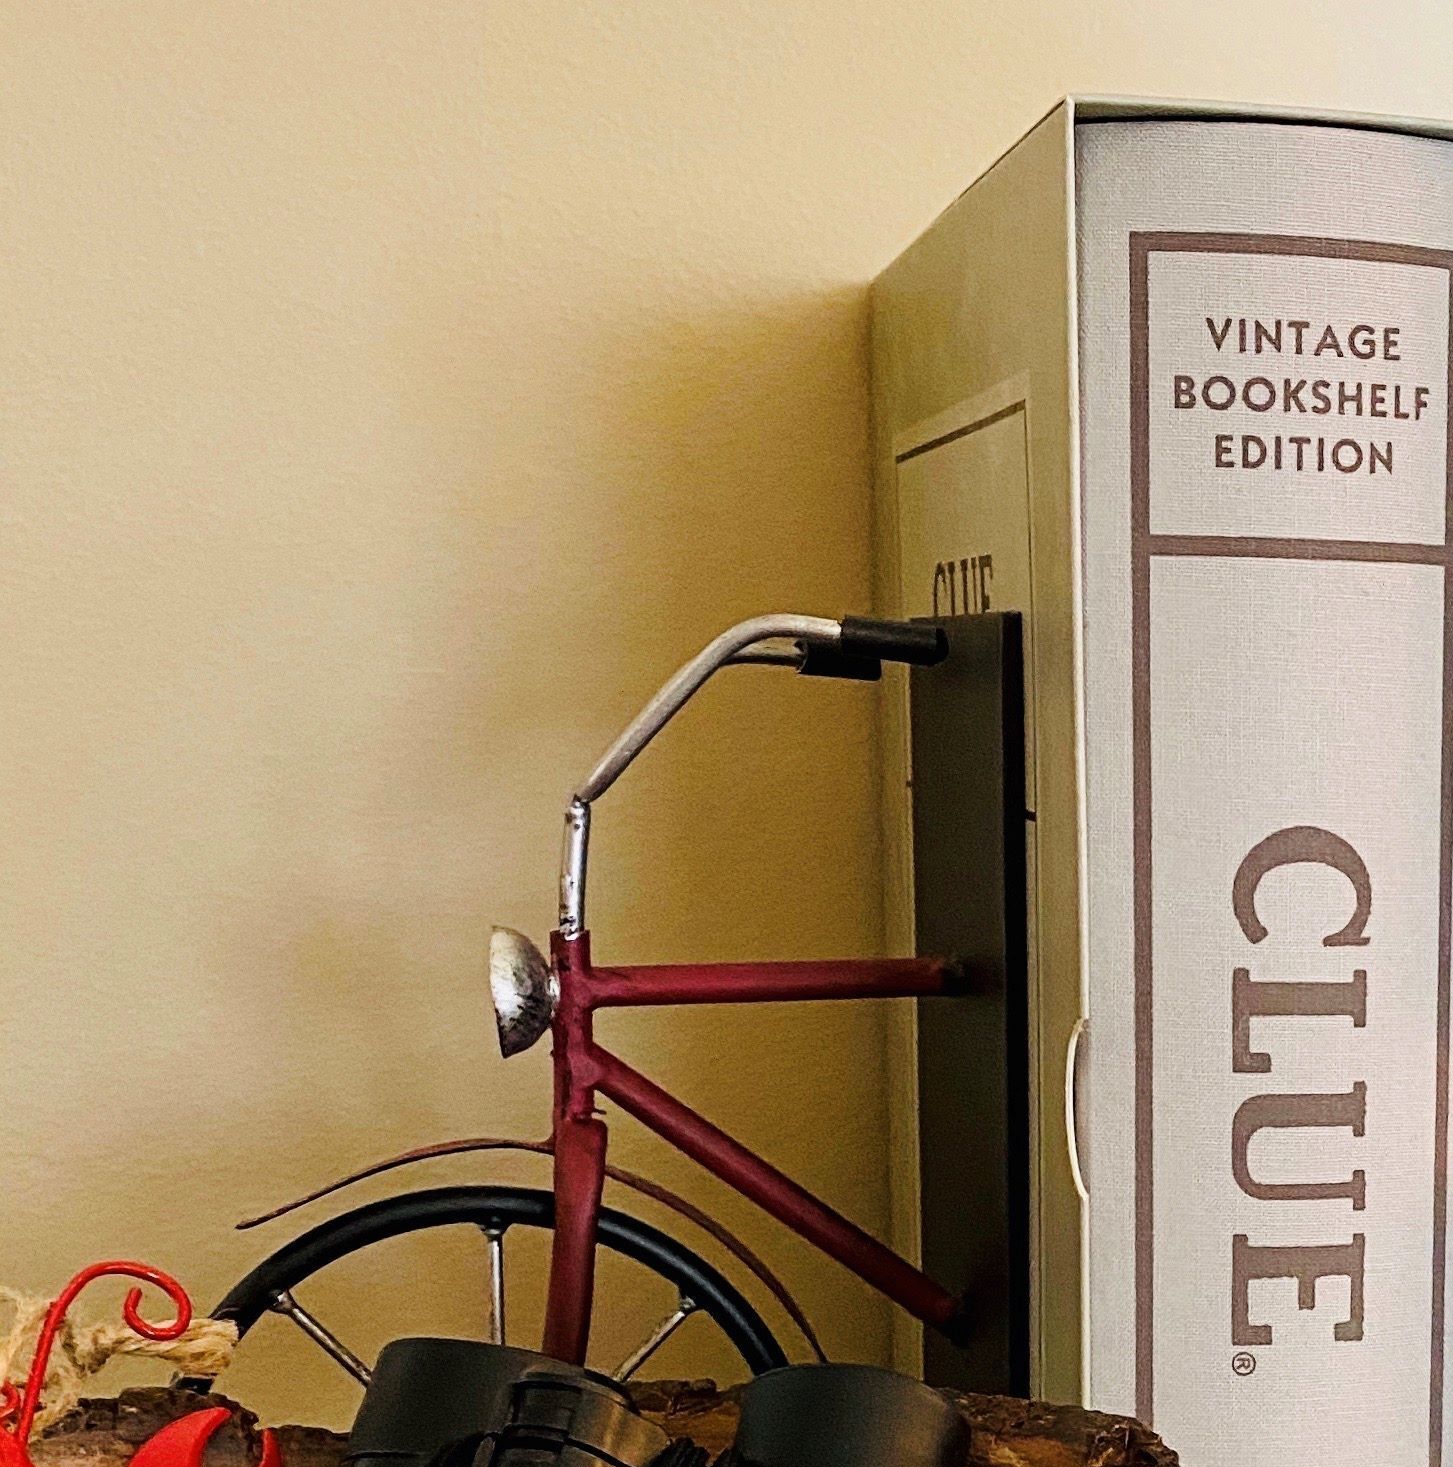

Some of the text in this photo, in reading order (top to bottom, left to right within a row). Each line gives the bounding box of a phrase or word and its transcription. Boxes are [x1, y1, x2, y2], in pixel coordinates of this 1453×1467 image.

[1204, 316, 1402, 362] VINTAGE
[1173, 375, 1430, 421] BOOKSHELF
[1213, 433, 1394, 475] EDITION
